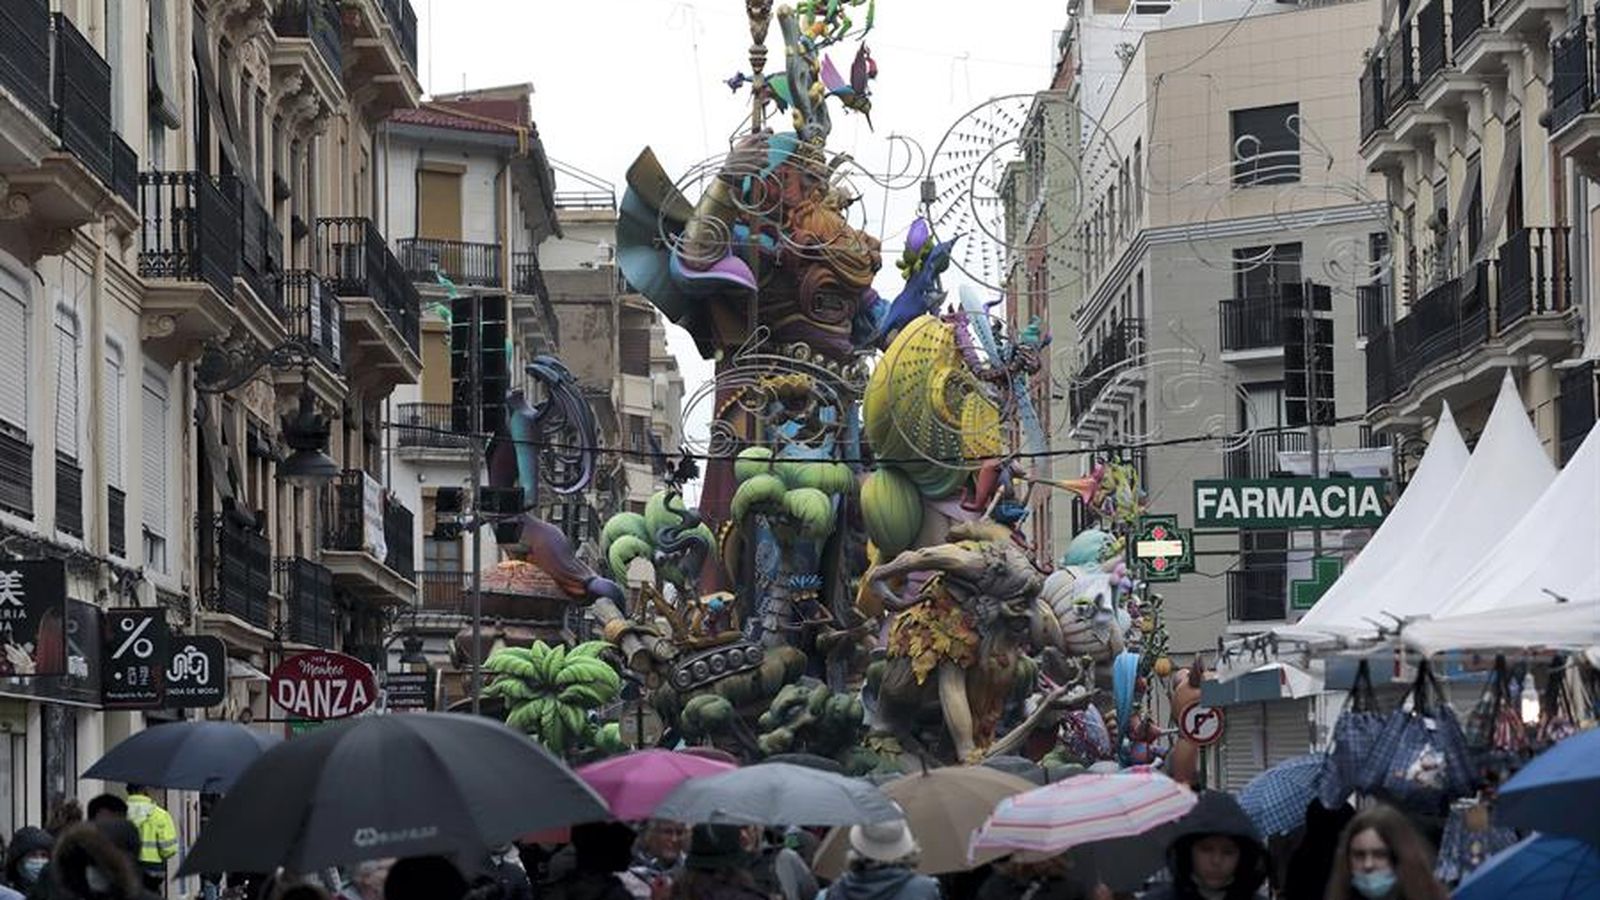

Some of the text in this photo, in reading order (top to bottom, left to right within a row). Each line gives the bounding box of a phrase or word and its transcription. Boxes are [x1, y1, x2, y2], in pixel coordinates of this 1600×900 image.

[1197, 486, 1382, 518] FARMACIA
[0, 609, 27, 618] RIA
[278, 679, 367, 718] DANZA
